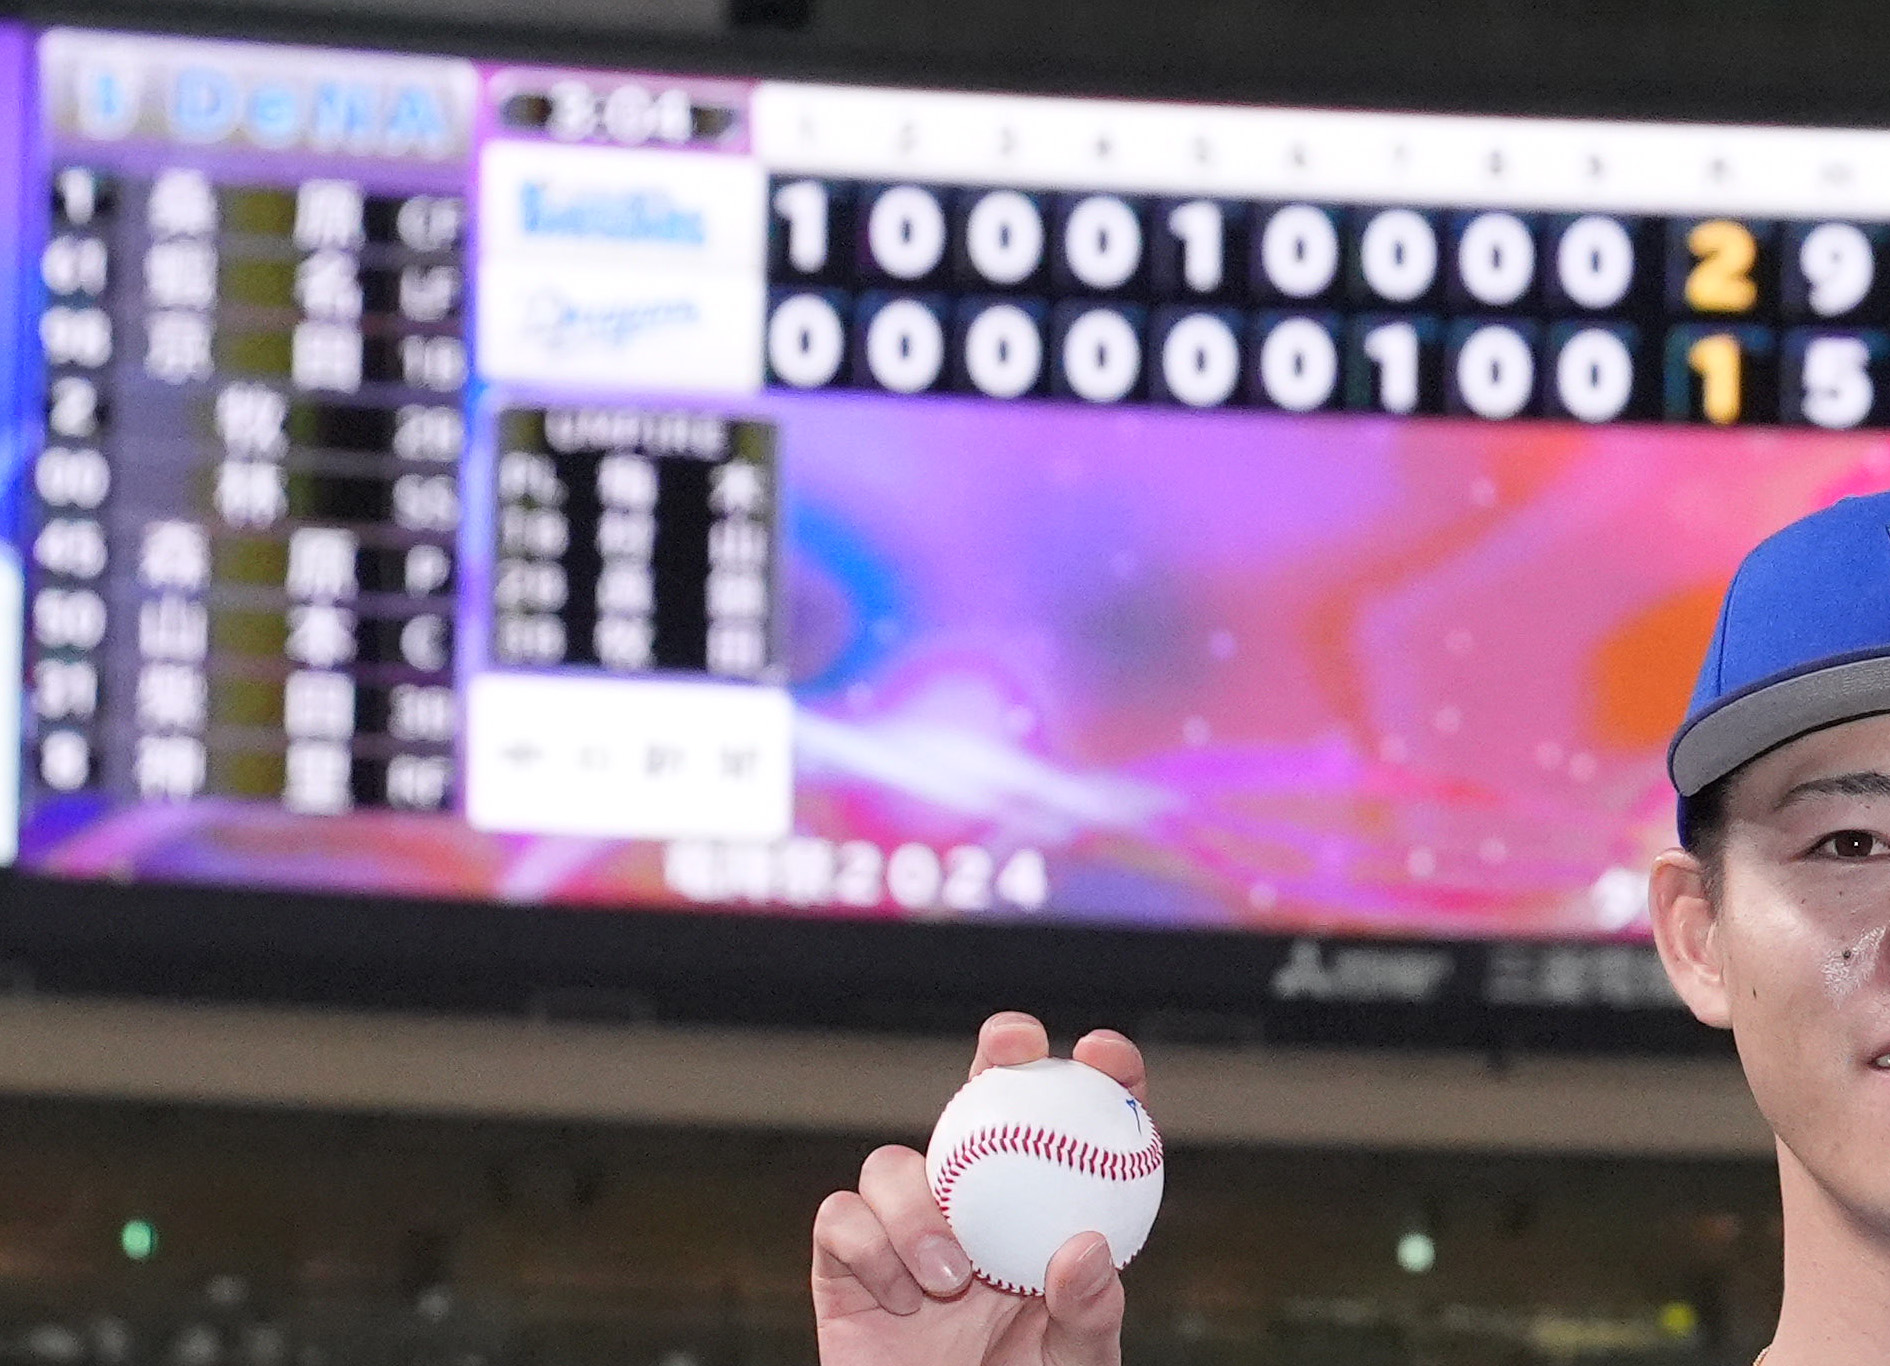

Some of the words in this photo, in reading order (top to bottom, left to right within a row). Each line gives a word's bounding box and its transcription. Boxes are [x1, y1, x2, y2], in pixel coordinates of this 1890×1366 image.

[170, 62, 450, 155] DeNA
[772, 176, 830, 273] 1
[866, 182, 948, 280] 0
[964, 186, 1045, 285] 0
[1062, 192, 1144, 290] 0
[1166, 197, 1225, 294] 1
[1259, 201, 1341, 298] 0
[1358, 205, 1440, 303] 0
[1455, 209, 1537, 307] 0
[1555, 211, 1636, 310] 0
[1683, 216, 1759, 315] 2
[1797, 219, 1876, 318] 9
[50, 376, 97, 437] 2
[765, 292, 846, 391] 0
[864, 297, 945, 397] 0
[962, 301, 1044, 401] 0
[1060, 307, 1142, 406] 0
[1159, 311, 1241, 410] 0
[1258, 315, 1339, 414] 0
[1362, 320, 1421, 417] 1
[1454, 323, 1536, 423] 0
[1554, 326, 1635, 425] 0
[1688, 332, 1744, 427] 1
[1800, 334, 1877, 432] 5
